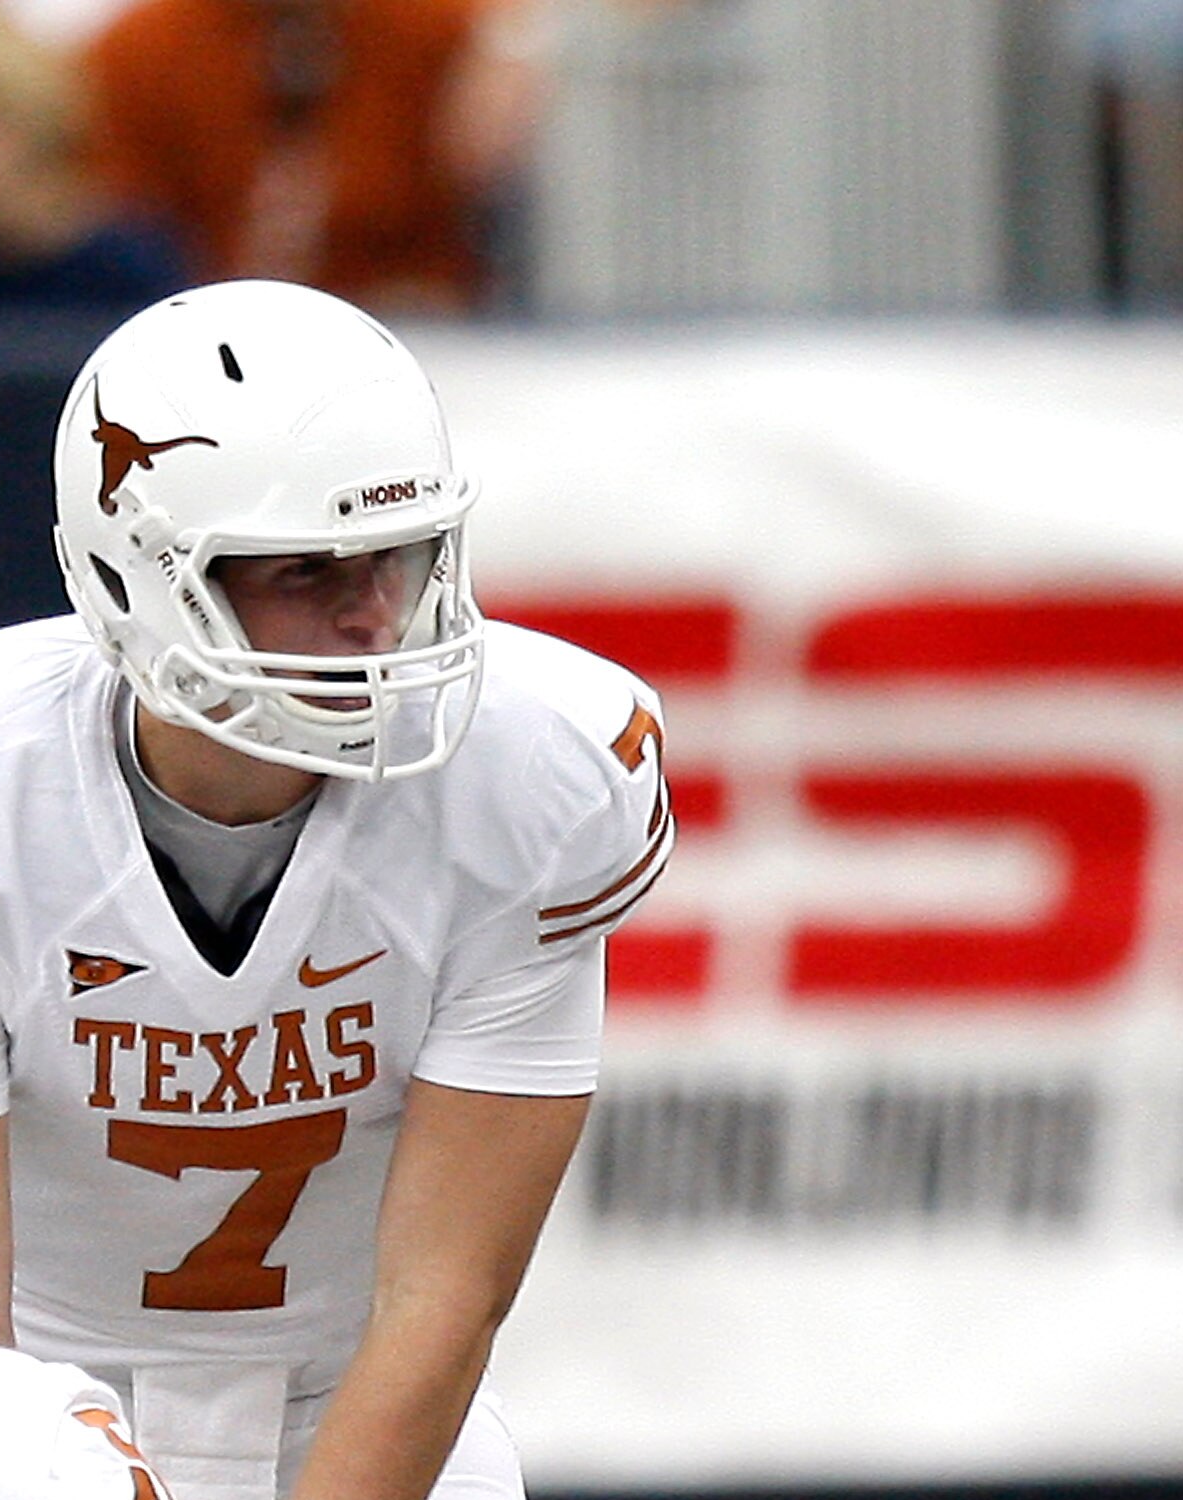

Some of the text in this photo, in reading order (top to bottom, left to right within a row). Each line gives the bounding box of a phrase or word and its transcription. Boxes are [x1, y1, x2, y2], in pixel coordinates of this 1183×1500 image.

[361, 478, 418, 508] HORNS
[73, 1001, 376, 1113] TEXAS
[107, 1106, 348, 1312] 7
